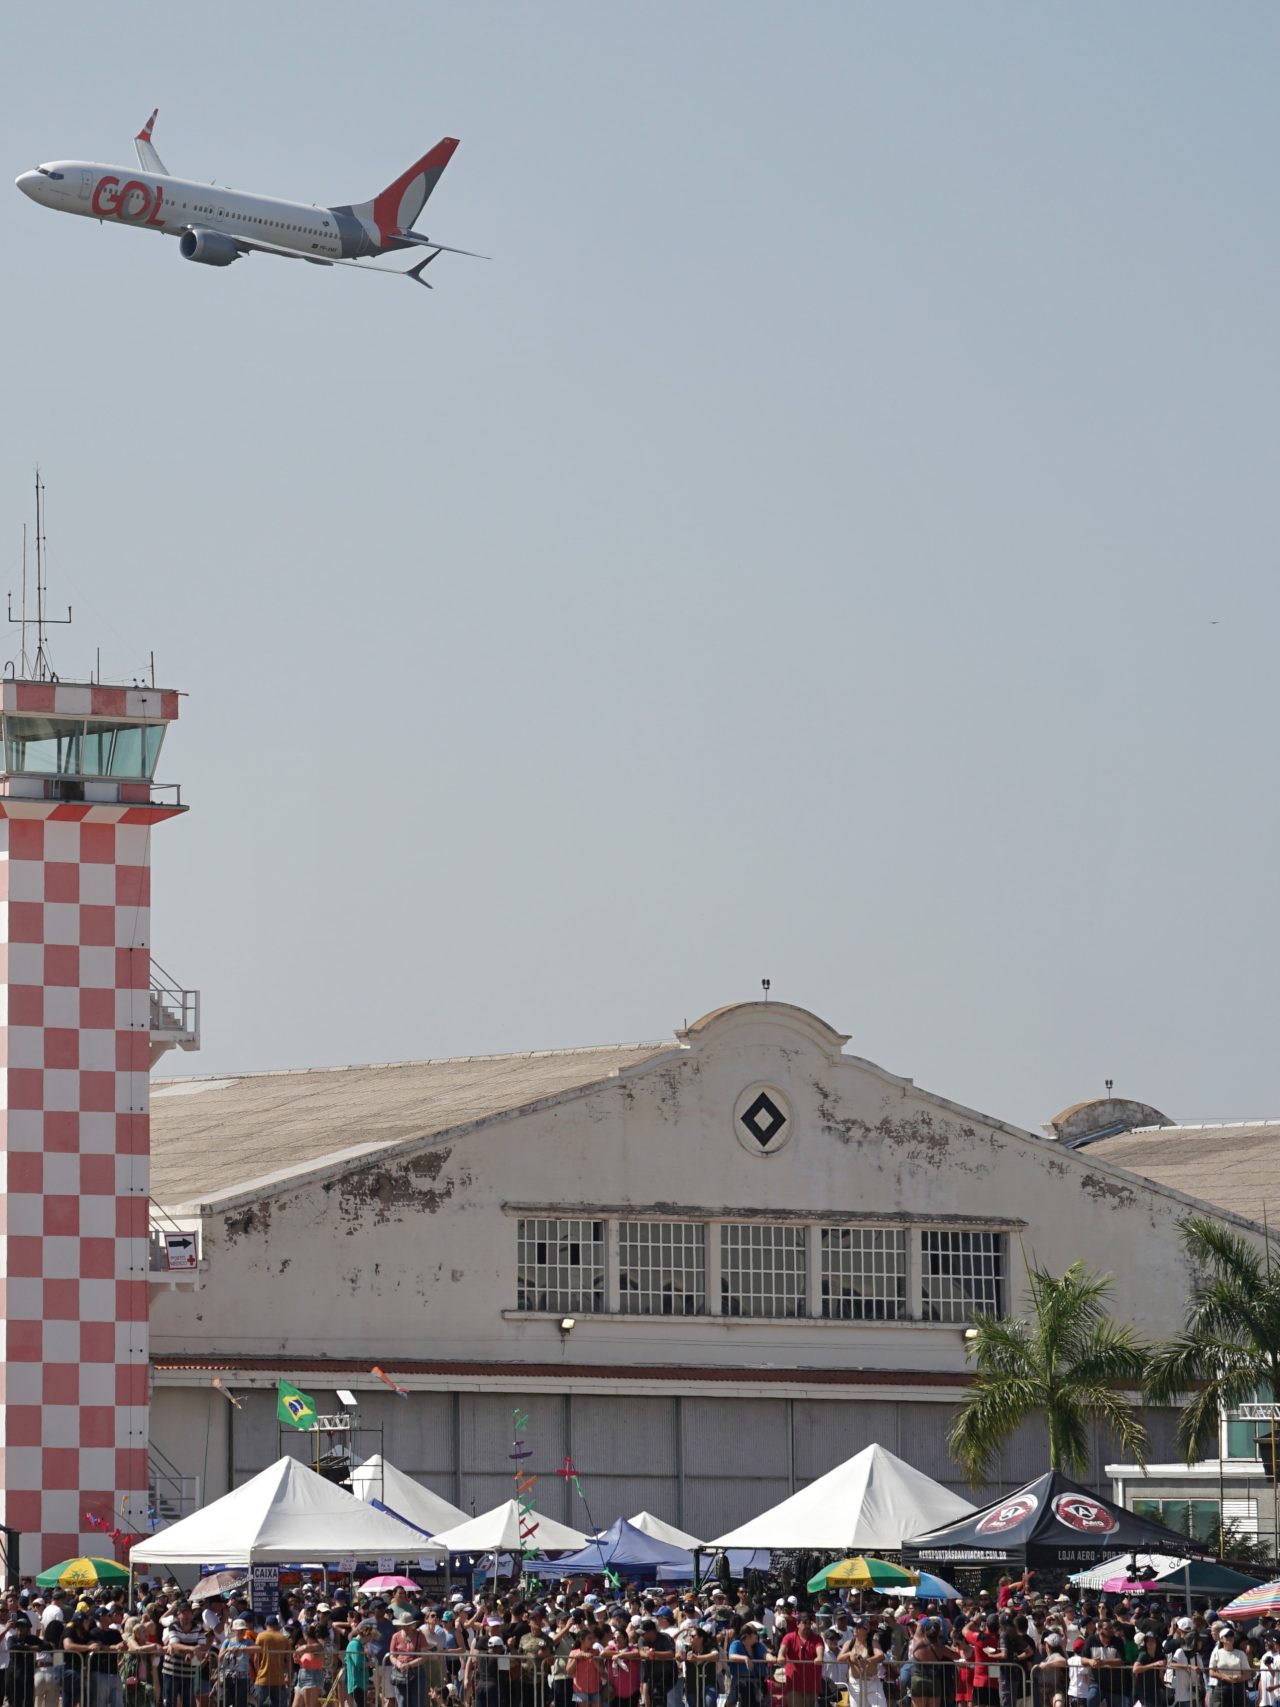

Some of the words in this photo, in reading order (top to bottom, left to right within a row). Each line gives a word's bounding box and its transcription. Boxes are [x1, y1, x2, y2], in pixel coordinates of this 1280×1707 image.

[92, 175, 166, 227] GOL
[1058, 1550, 1075, 1561] LOJA
[1077, 1550, 1095, 1561] AERO
[254, 1568, 278, 1578] CAIXA
